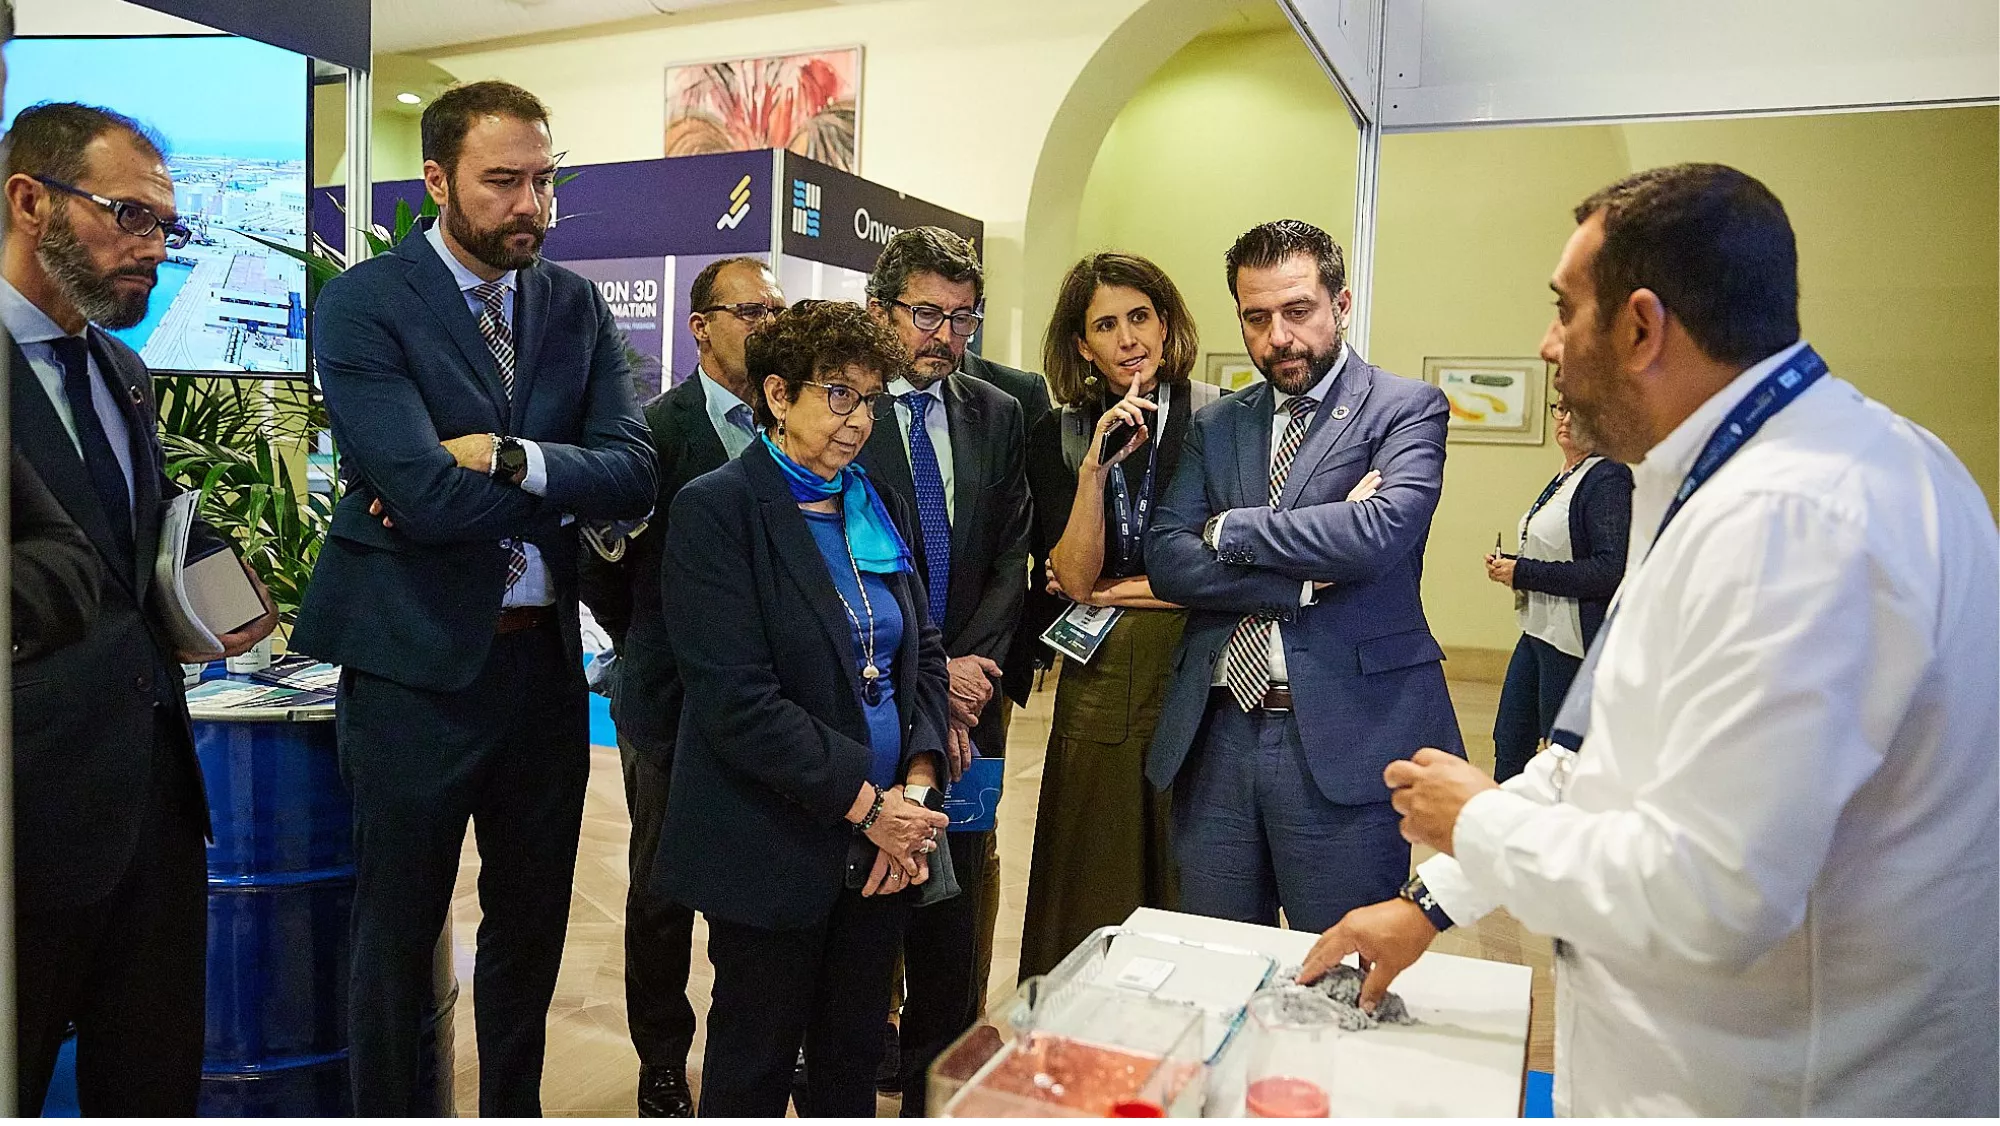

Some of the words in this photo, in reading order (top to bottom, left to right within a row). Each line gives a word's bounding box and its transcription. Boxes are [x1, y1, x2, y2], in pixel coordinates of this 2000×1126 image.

[854, 207, 904, 245] Onve
[595, 280, 630, 302] ION
[633, 279, 657, 302] 3D
[608, 302, 657, 318] MATION
